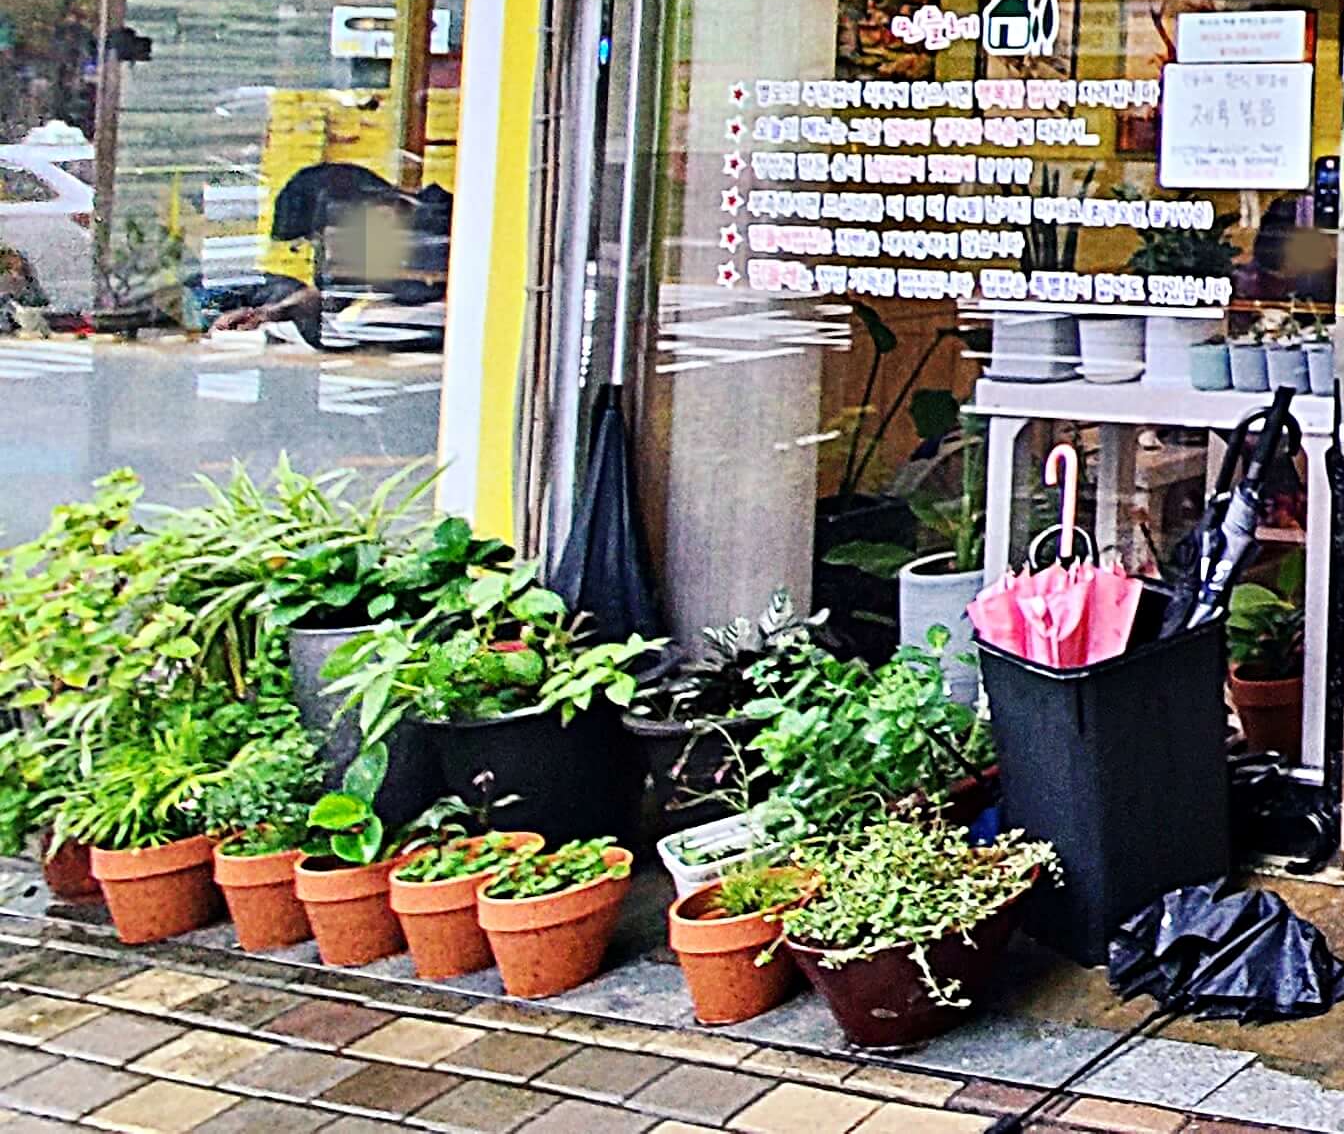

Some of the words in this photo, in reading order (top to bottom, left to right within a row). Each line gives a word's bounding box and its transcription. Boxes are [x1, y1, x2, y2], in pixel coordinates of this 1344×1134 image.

[1079, 80, 1160, 108] 차려집니다
[753, 116, 799, 142] 오늘의
[961, 229, 1024, 258] 않습니다
[1148, 276, 1231, 305] 맛있습니다
